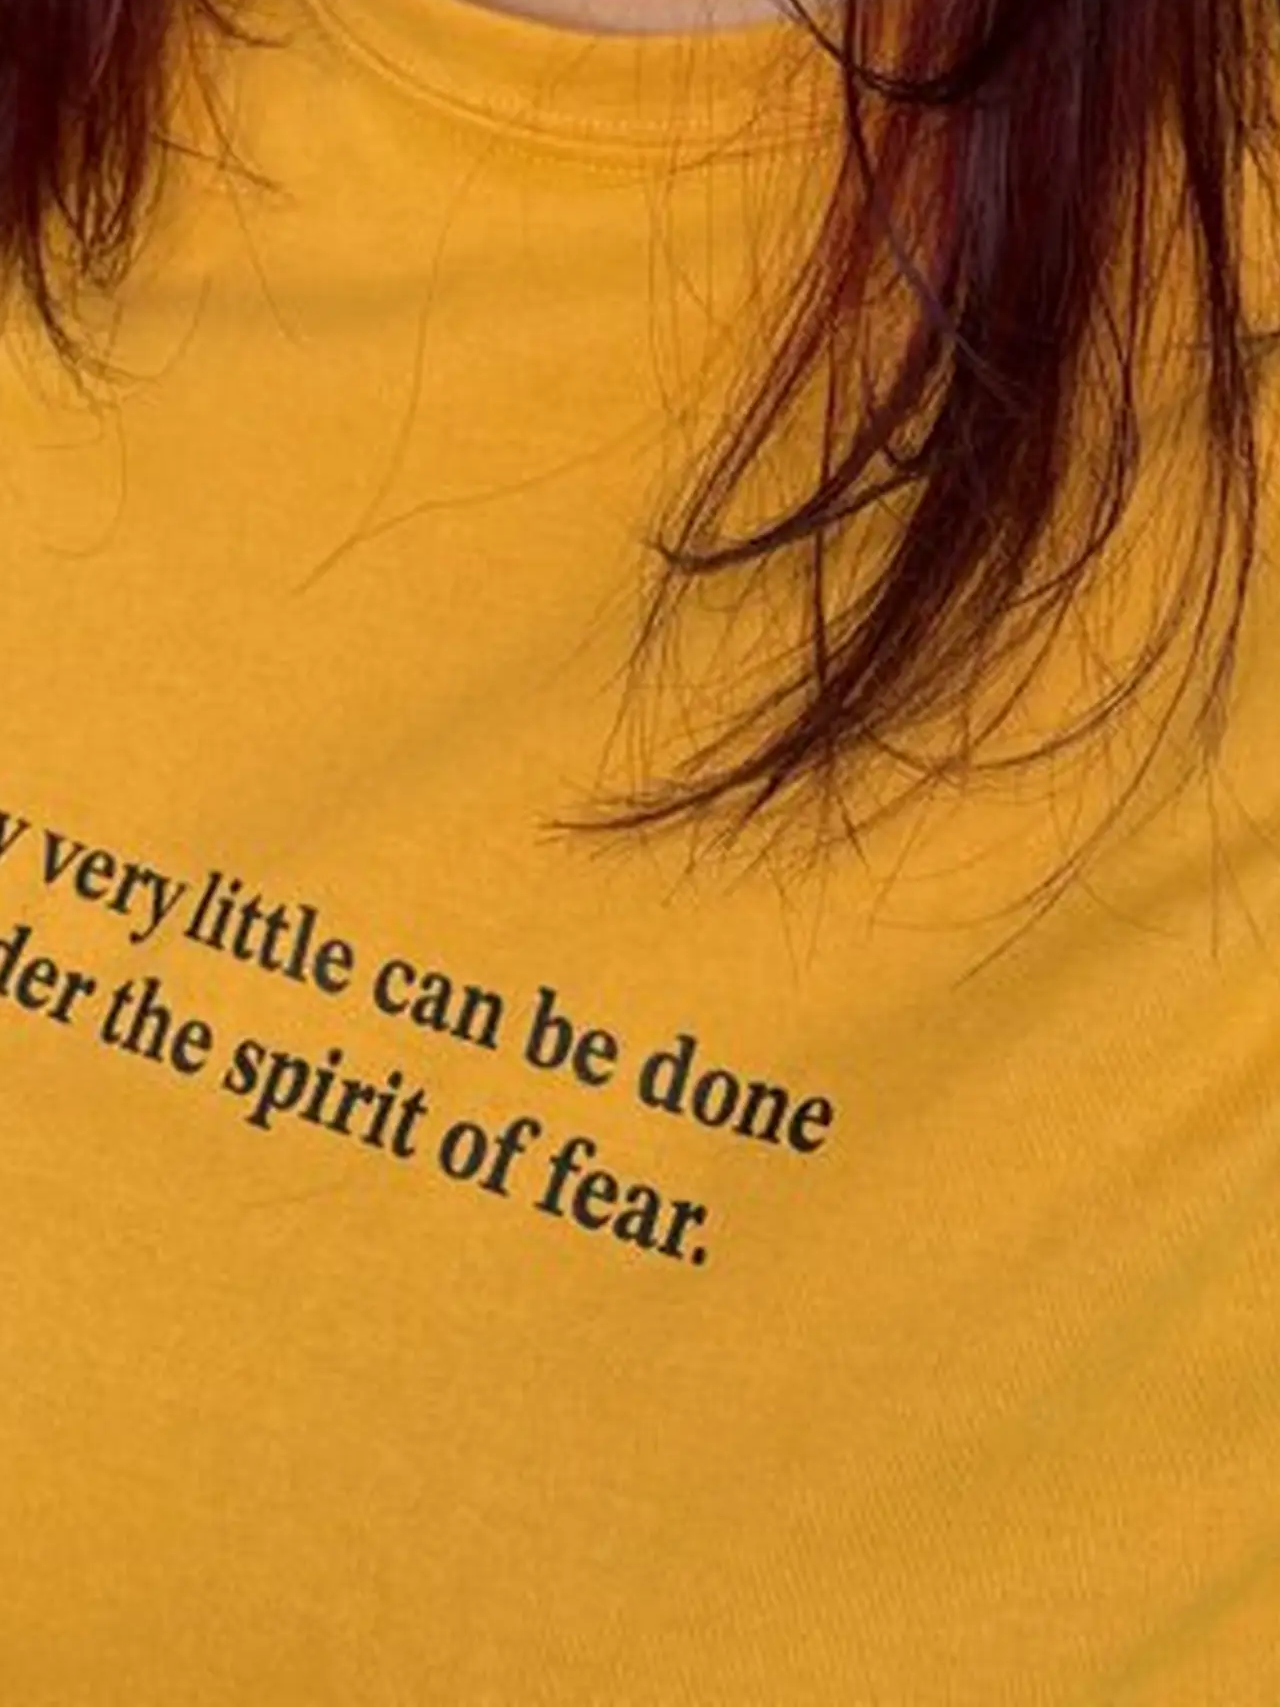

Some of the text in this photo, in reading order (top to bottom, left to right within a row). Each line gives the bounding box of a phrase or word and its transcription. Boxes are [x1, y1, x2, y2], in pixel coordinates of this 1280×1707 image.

[45, 831, 186, 944] very
[184, 871, 353, 993] little
[374, 960, 502, 1050] can
[526, 987, 617, 1086] be
[640, 1035, 833, 1153] done
[101, 978, 212, 1074] the
[223, 1040, 427, 1158] spirit
[439, 1118, 541, 1197] of
[535, 1137, 707, 1265] fear.
